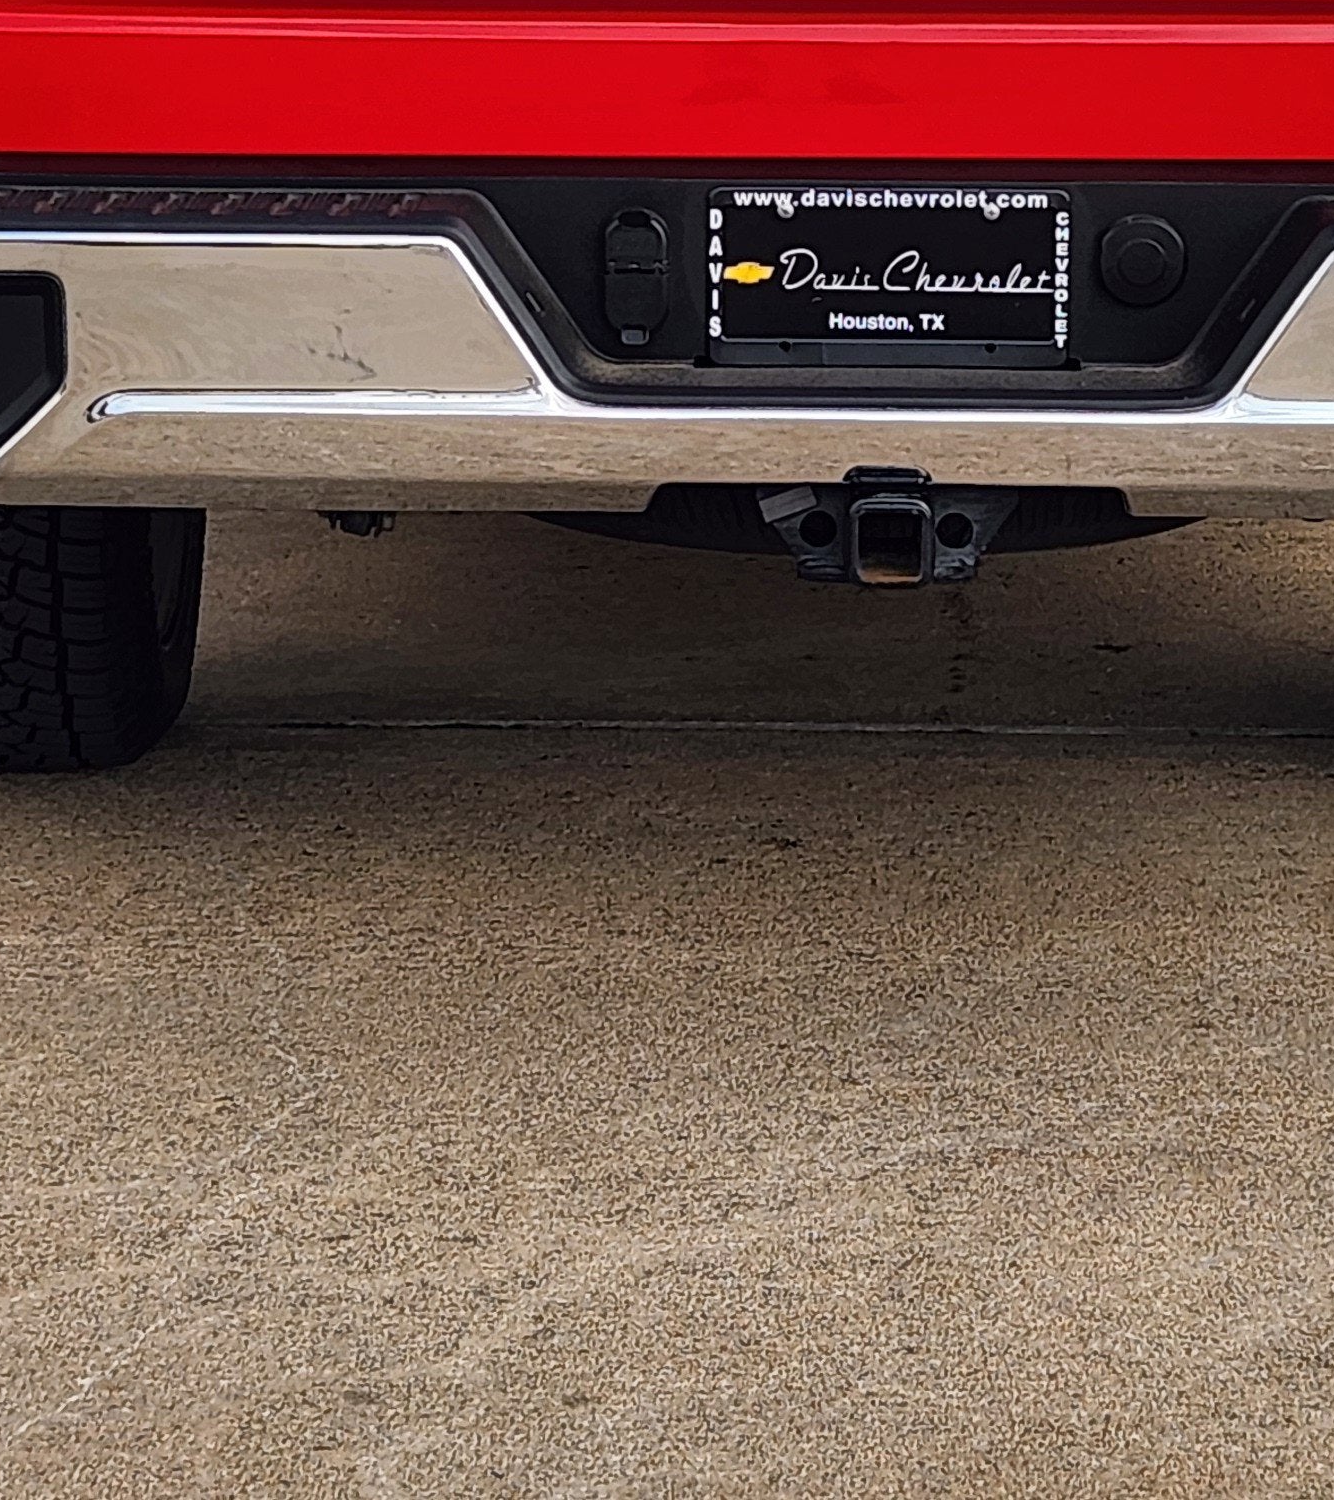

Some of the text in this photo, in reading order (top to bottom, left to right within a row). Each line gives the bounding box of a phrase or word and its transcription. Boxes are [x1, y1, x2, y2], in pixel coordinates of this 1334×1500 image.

[733, 189, 1049, 209] www.davischevrolet.com
[709, 208, 723, 338] DAVIS
[779, 247, 1055, 293] Davis Chevrolet
[1055, 211, 1069, 348] CHEVROLET
[828, 312, 945, 333] Houston, TX
